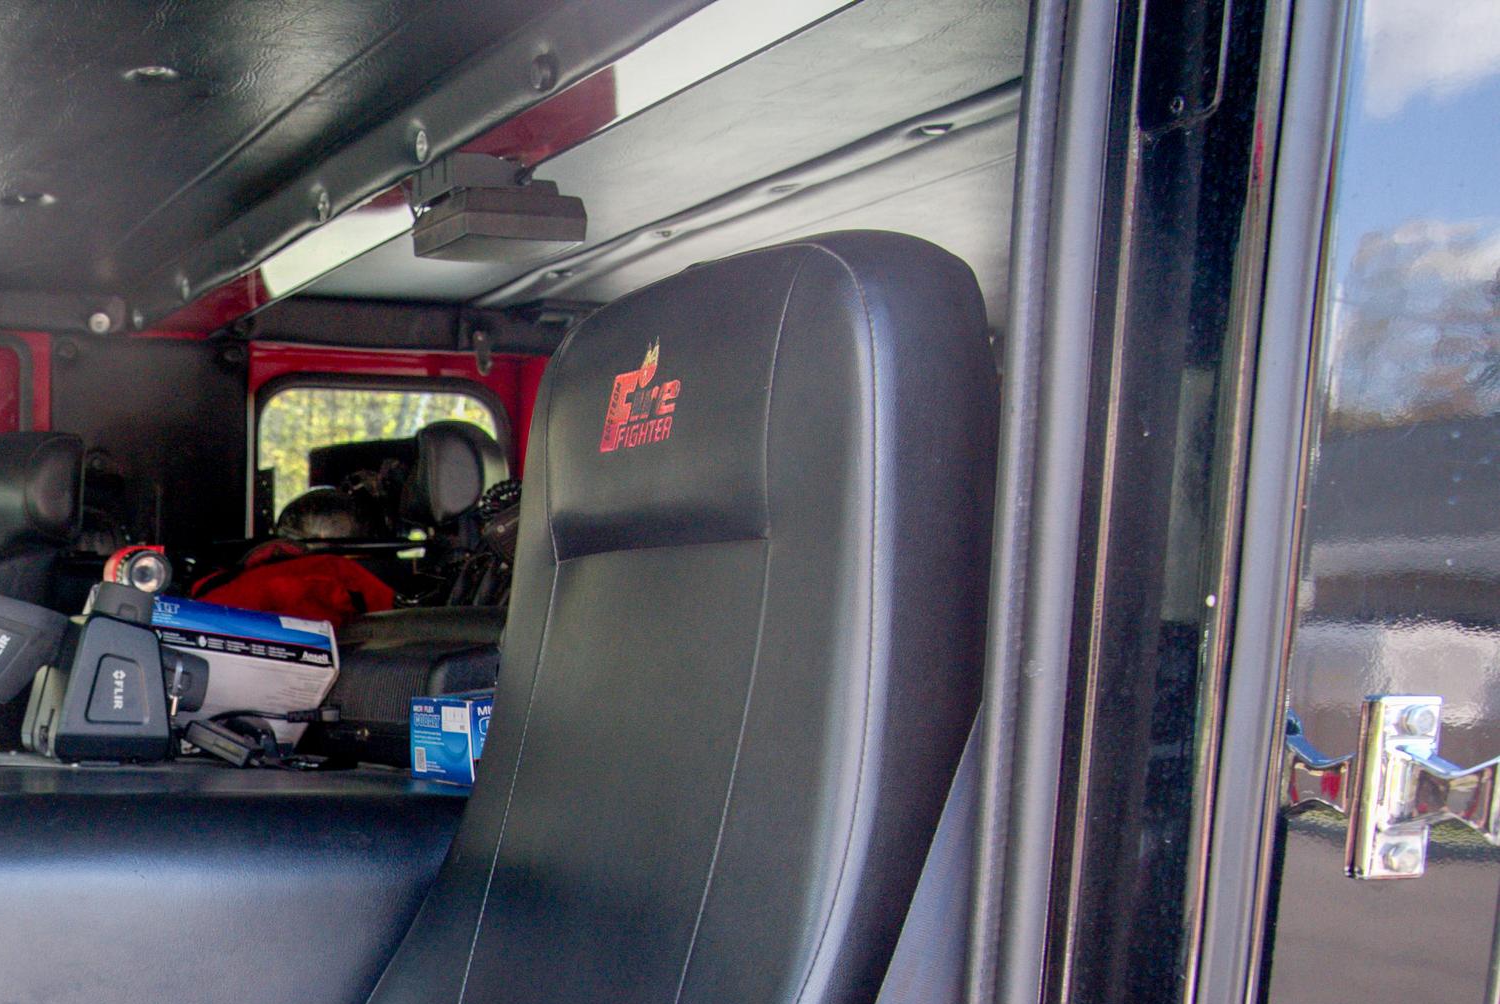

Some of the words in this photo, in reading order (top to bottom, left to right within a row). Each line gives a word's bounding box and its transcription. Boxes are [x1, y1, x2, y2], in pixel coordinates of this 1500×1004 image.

[614, 416, 673, 449] FIGHTER
[302, 650, 329, 664] Ansell
[113, 680, 124, 710] FLIR
